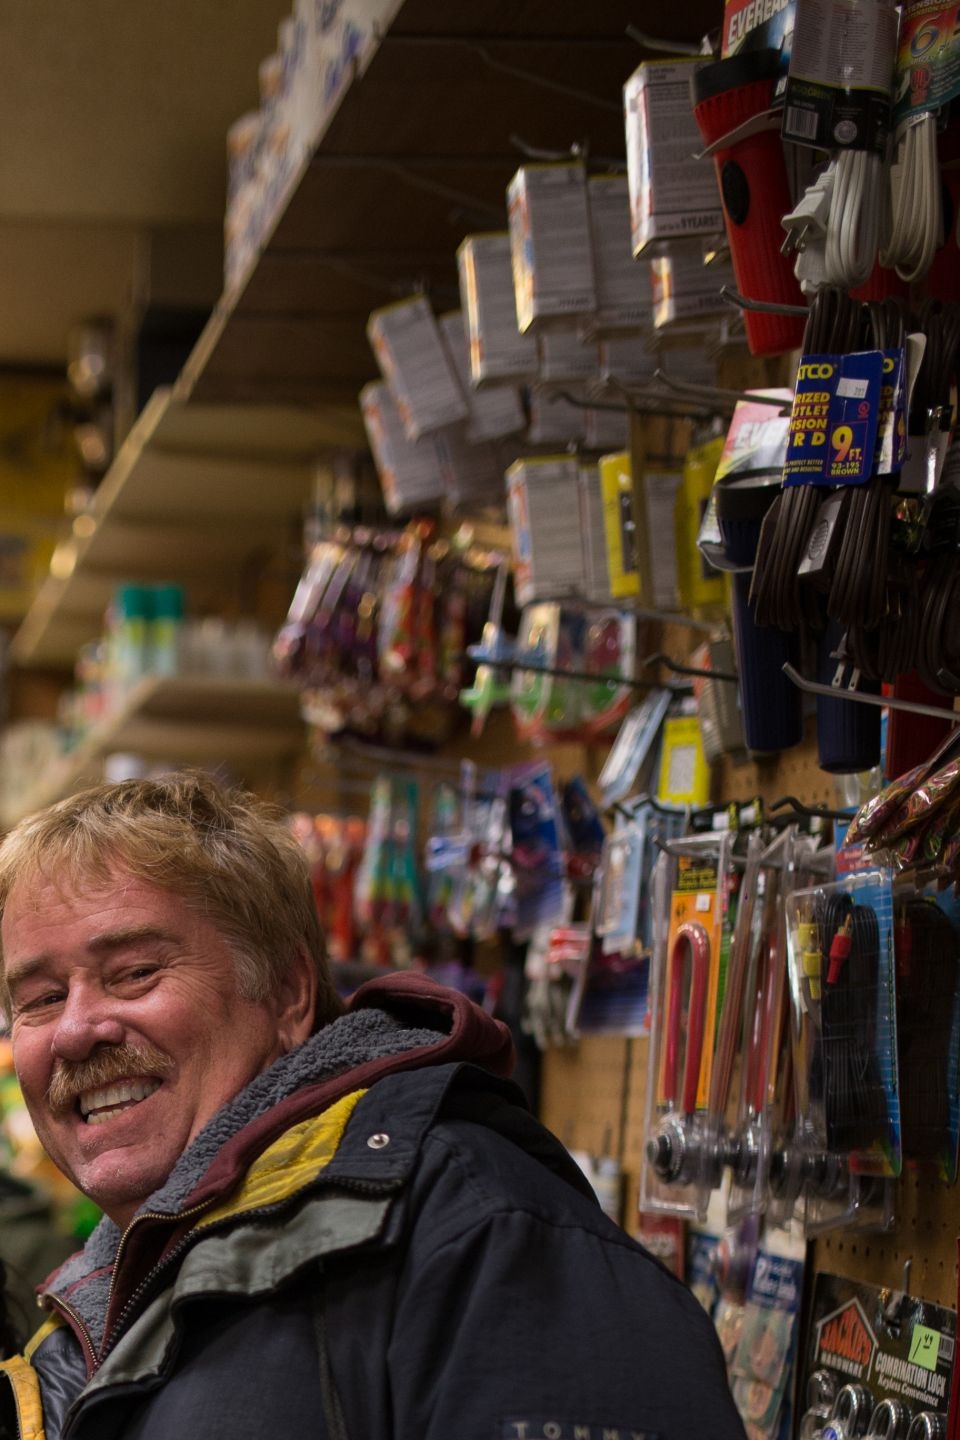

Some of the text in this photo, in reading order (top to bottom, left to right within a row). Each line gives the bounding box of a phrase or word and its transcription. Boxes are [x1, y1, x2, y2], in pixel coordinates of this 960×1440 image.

[831, 425, 853, 462] 9
[831, 468, 860, 476] BROWN
[820, 1350, 863, 1378] HARDWARE
[875, 1352, 946, 1398] COMBINATION LOCK
[877, 1374, 940, 1407] Keyless Convenience
